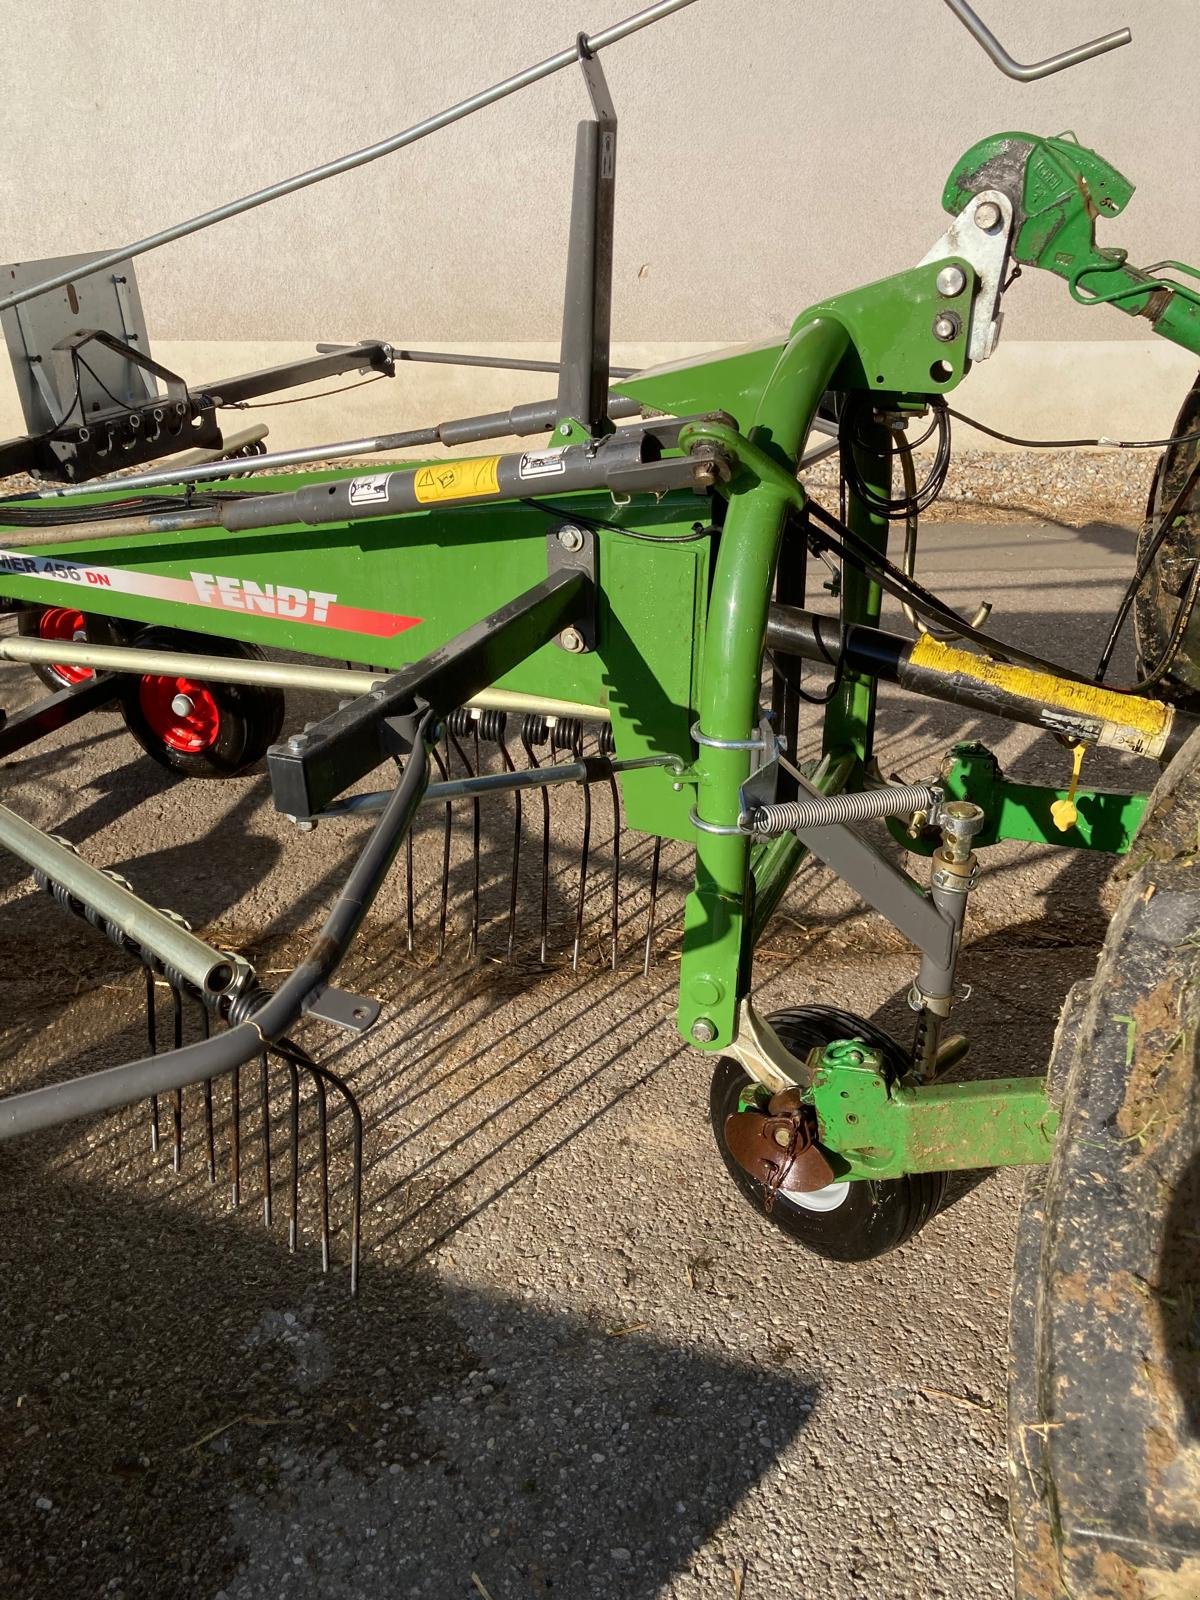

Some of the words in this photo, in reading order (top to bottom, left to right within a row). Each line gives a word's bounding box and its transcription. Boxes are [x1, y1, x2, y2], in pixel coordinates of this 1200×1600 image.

[43, 562, 81, 581] 456
[85, 571, 111, 586] DN
[190, 571, 338, 622] FENDT
